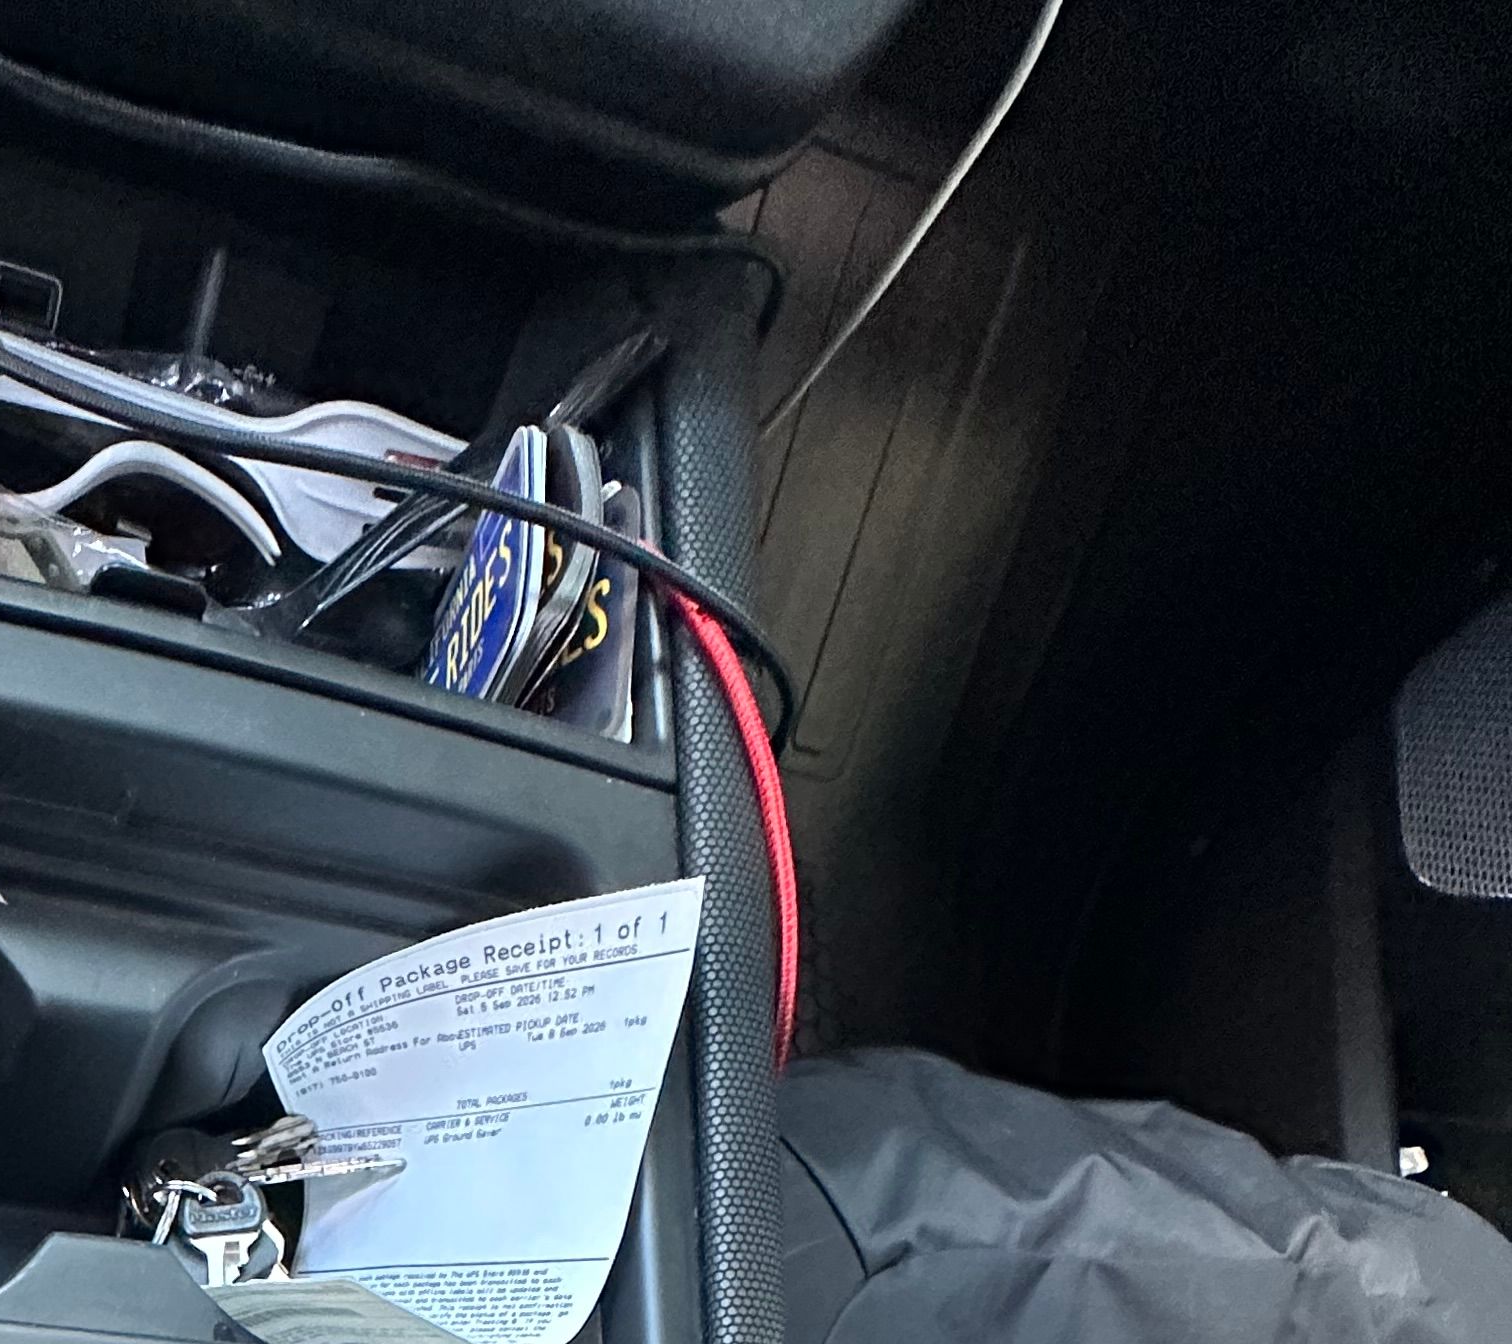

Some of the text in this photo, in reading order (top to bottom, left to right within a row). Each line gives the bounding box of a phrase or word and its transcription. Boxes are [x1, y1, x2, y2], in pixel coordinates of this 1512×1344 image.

[446, 519, 513, 690] RIDES
[379, 955, 471, 993] Package
[483, 929, 584, 965] Receipt:
[594, 923, 602, 944] 1
[617, 914, 642, 940] of
[659, 911, 668, 935] 1
[505, 961, 531, 976] SAVE
[536, 957, 557, 971] FOR
[562, 951, 588, 966] YOUR
